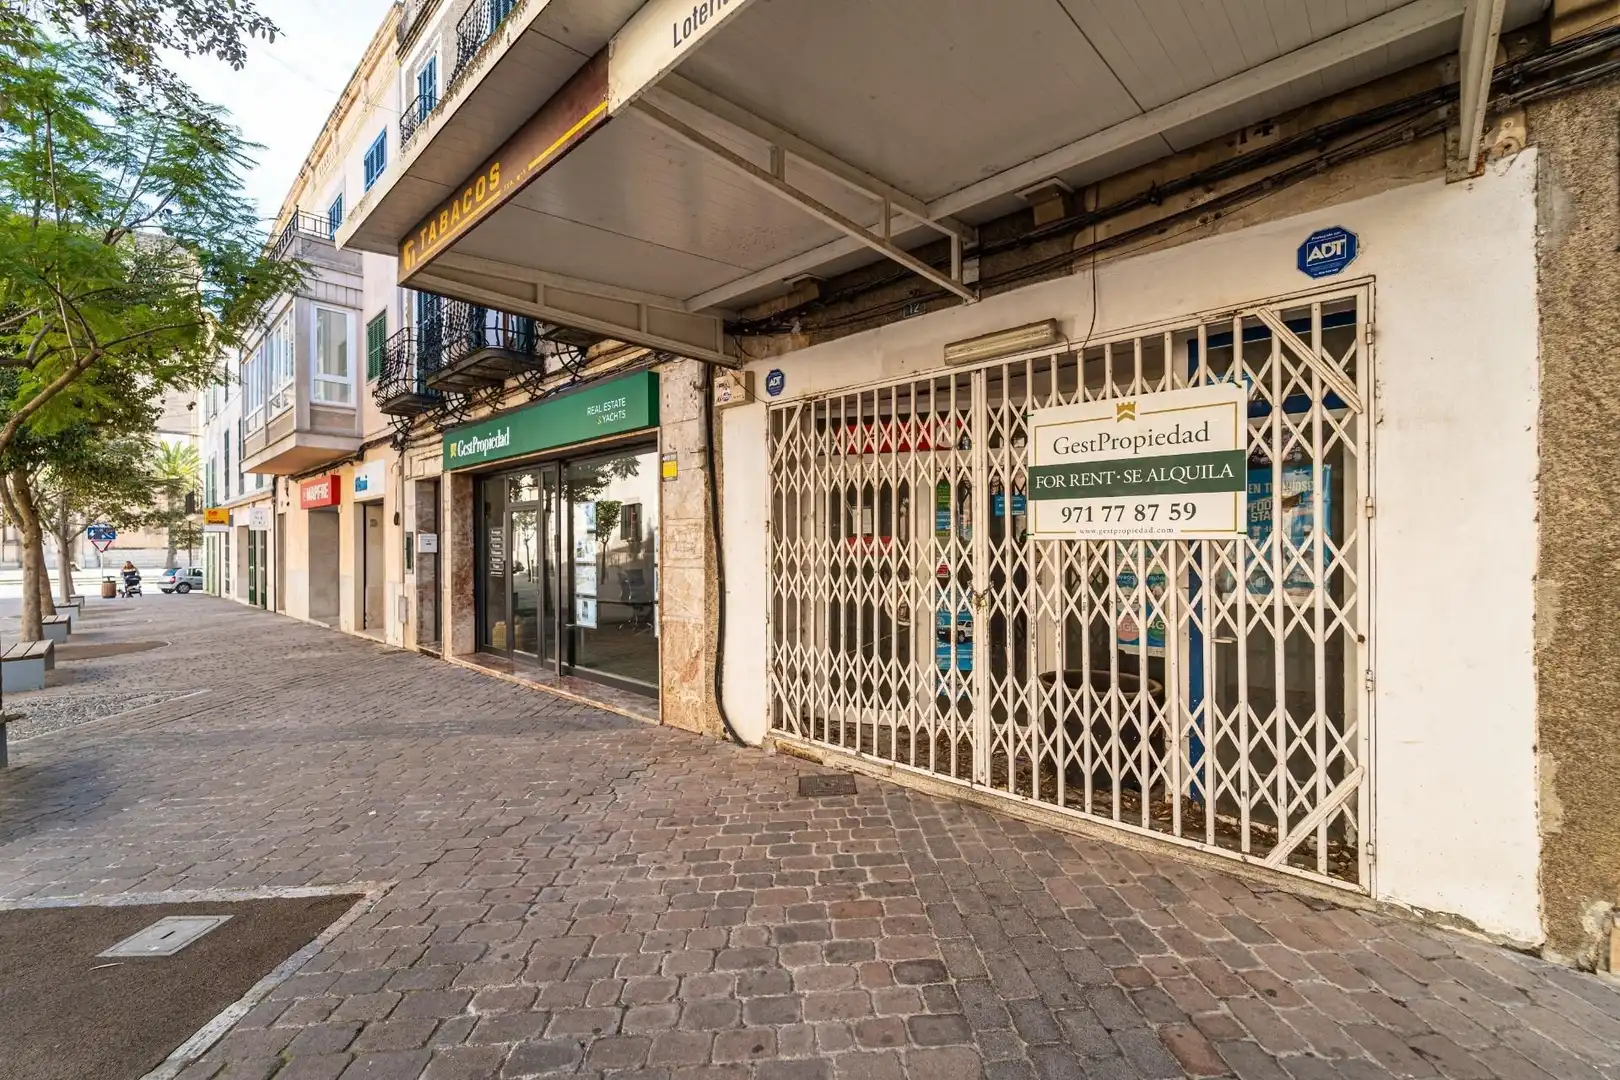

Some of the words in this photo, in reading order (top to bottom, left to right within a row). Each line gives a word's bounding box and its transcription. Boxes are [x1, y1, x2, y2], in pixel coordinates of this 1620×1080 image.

[672, 0, 729, 49] Loter
[419, 161, 502, 251] TABACOS
[1307, 239, 1346, 262] ADT
[768, 375, 782, 388] ADT
[586, 403, 603, 417] REAL
[603, 396, 626, 412] ESTATE
[601, 409, 627, 424] YACHTS
[457, 426, 511, 459] GestPropiedad
[1053, 421, 1211, 455] GestPropiedad
[1035, 475, 1066, 490] FOR
[1145, 463, 1235, 484] ALQUILA
[306, 482, 329, 502] MAPFRE
[1061, 506, 1094, 524] 971
[1101, 505, 1126, 523] 77
[1134, 503, 1160, 522] 87
[1168, 502, 1197, 522] 59
[1079, 526, 1174, 536] www.gestpropiedad.com
